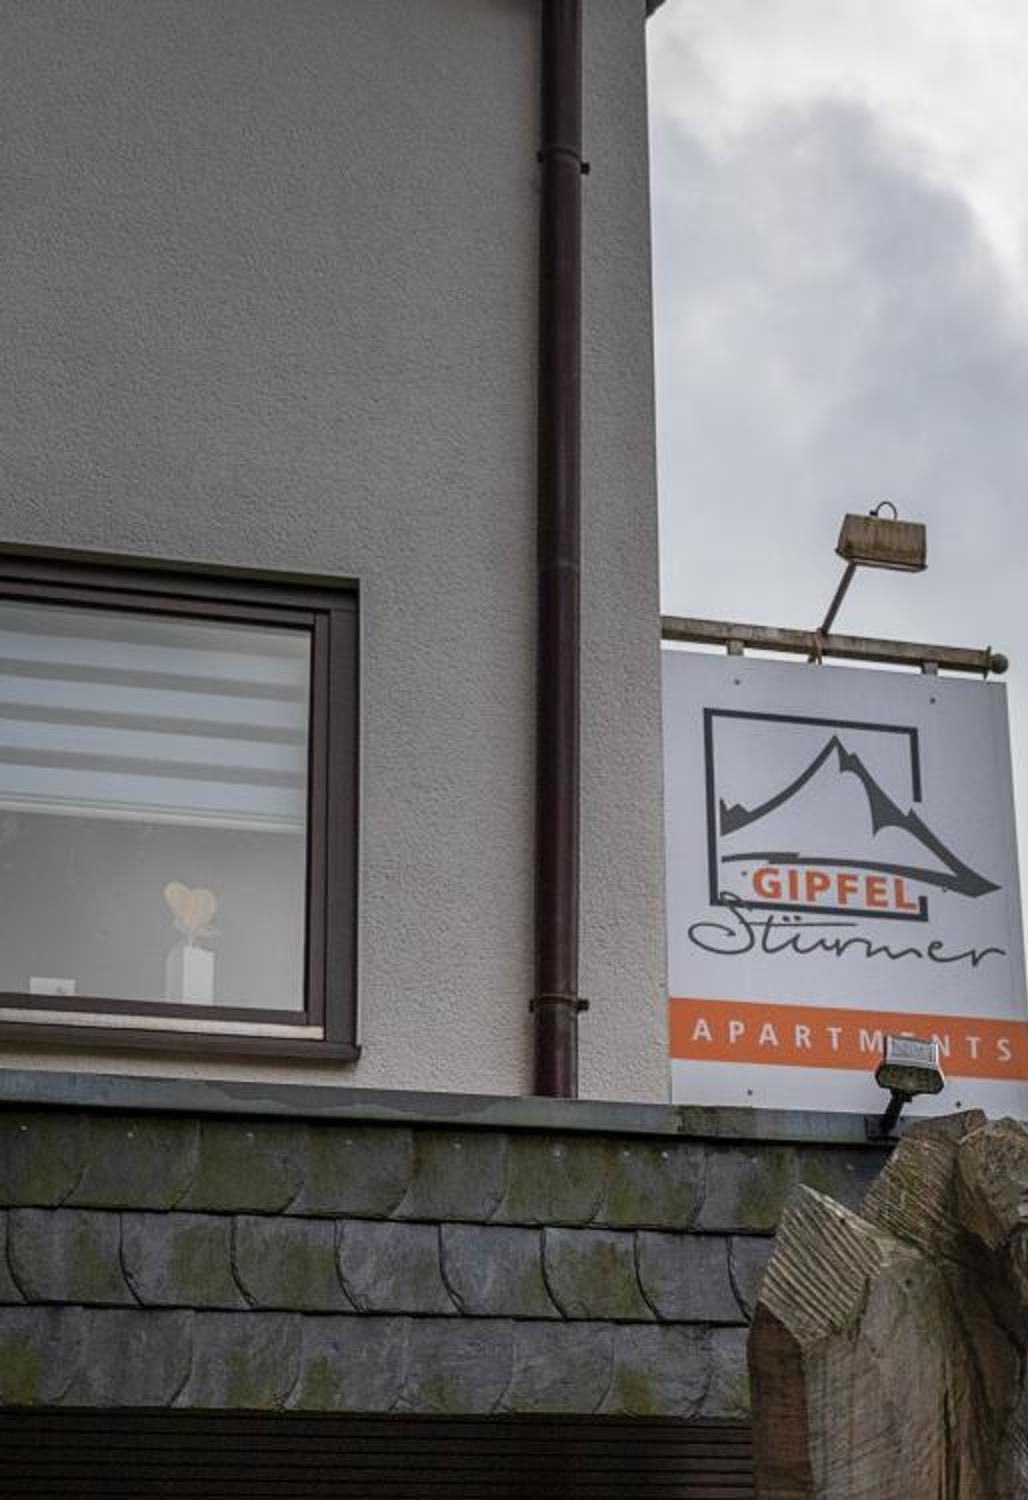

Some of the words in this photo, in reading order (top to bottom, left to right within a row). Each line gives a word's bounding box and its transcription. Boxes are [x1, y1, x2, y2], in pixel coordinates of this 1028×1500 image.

[752, 866, 919, 911] GIPFEL
[688, 891, 1006, 966] Stürmer
[692, 1017, 1012, 1062] APARTMNTS
